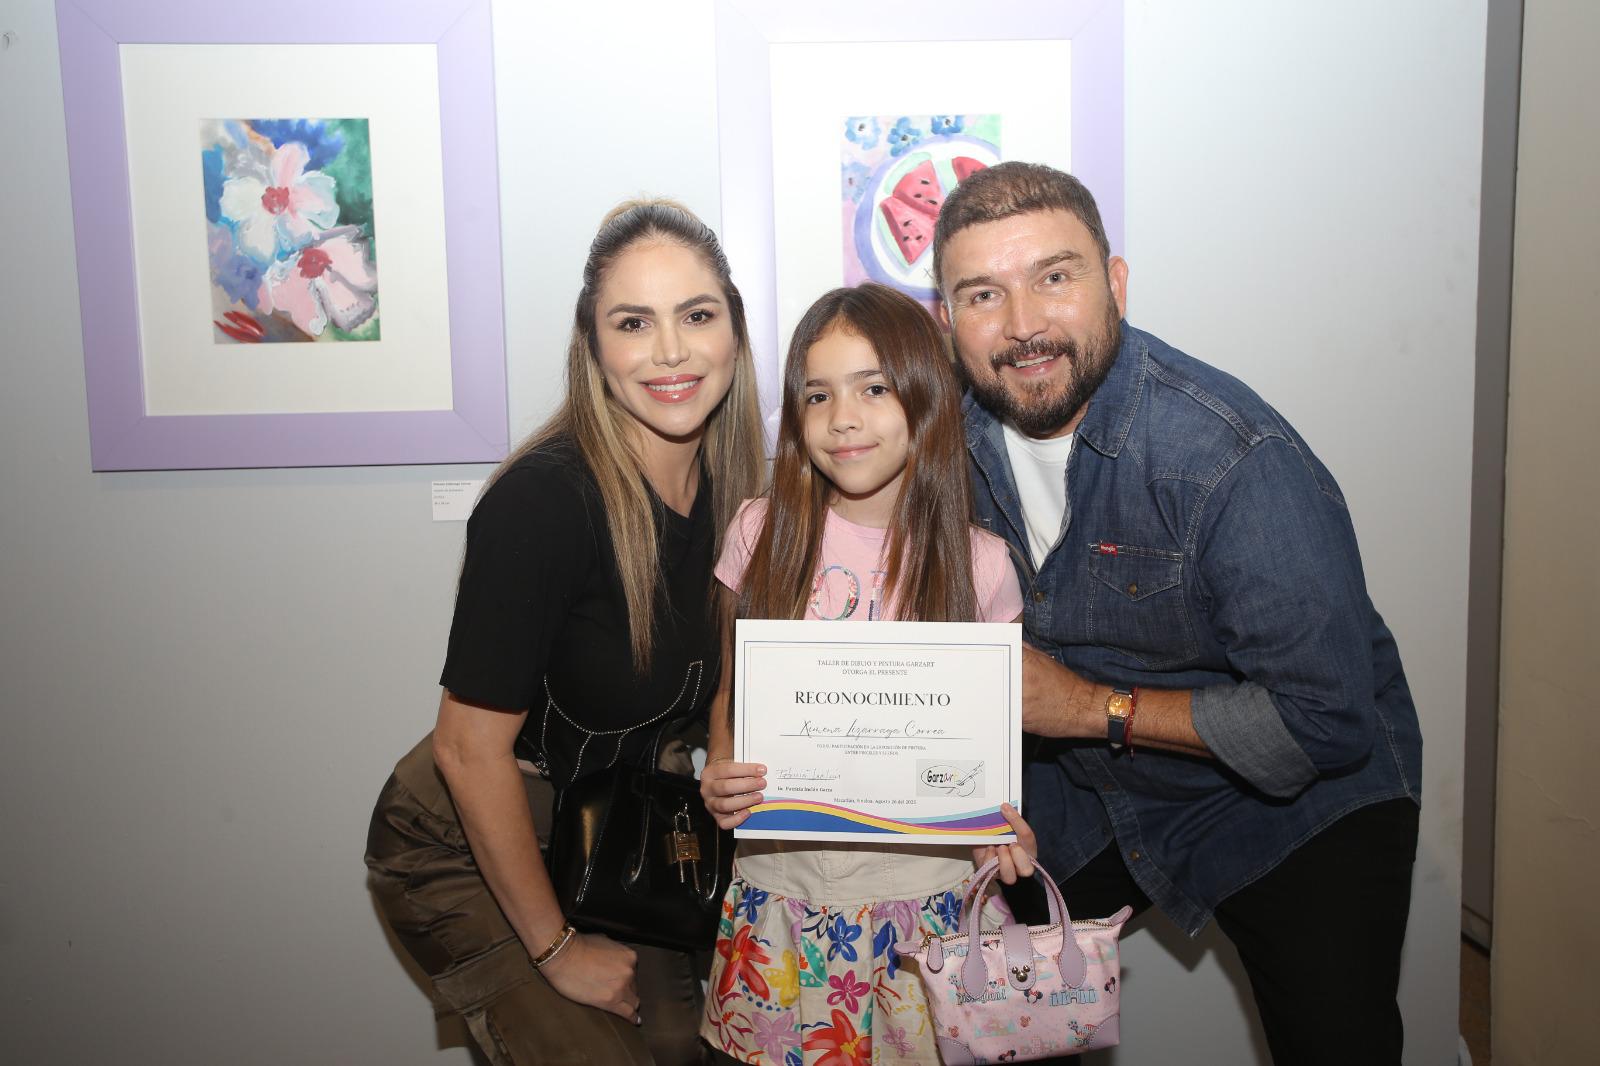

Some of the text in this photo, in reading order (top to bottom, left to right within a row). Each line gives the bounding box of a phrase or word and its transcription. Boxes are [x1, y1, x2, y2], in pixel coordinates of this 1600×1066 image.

[794, 691, 951, 706] RECONOCIMIENTO
[800, 719, 842, 738] Ximena
[904, 719, 945, 737] Correa
